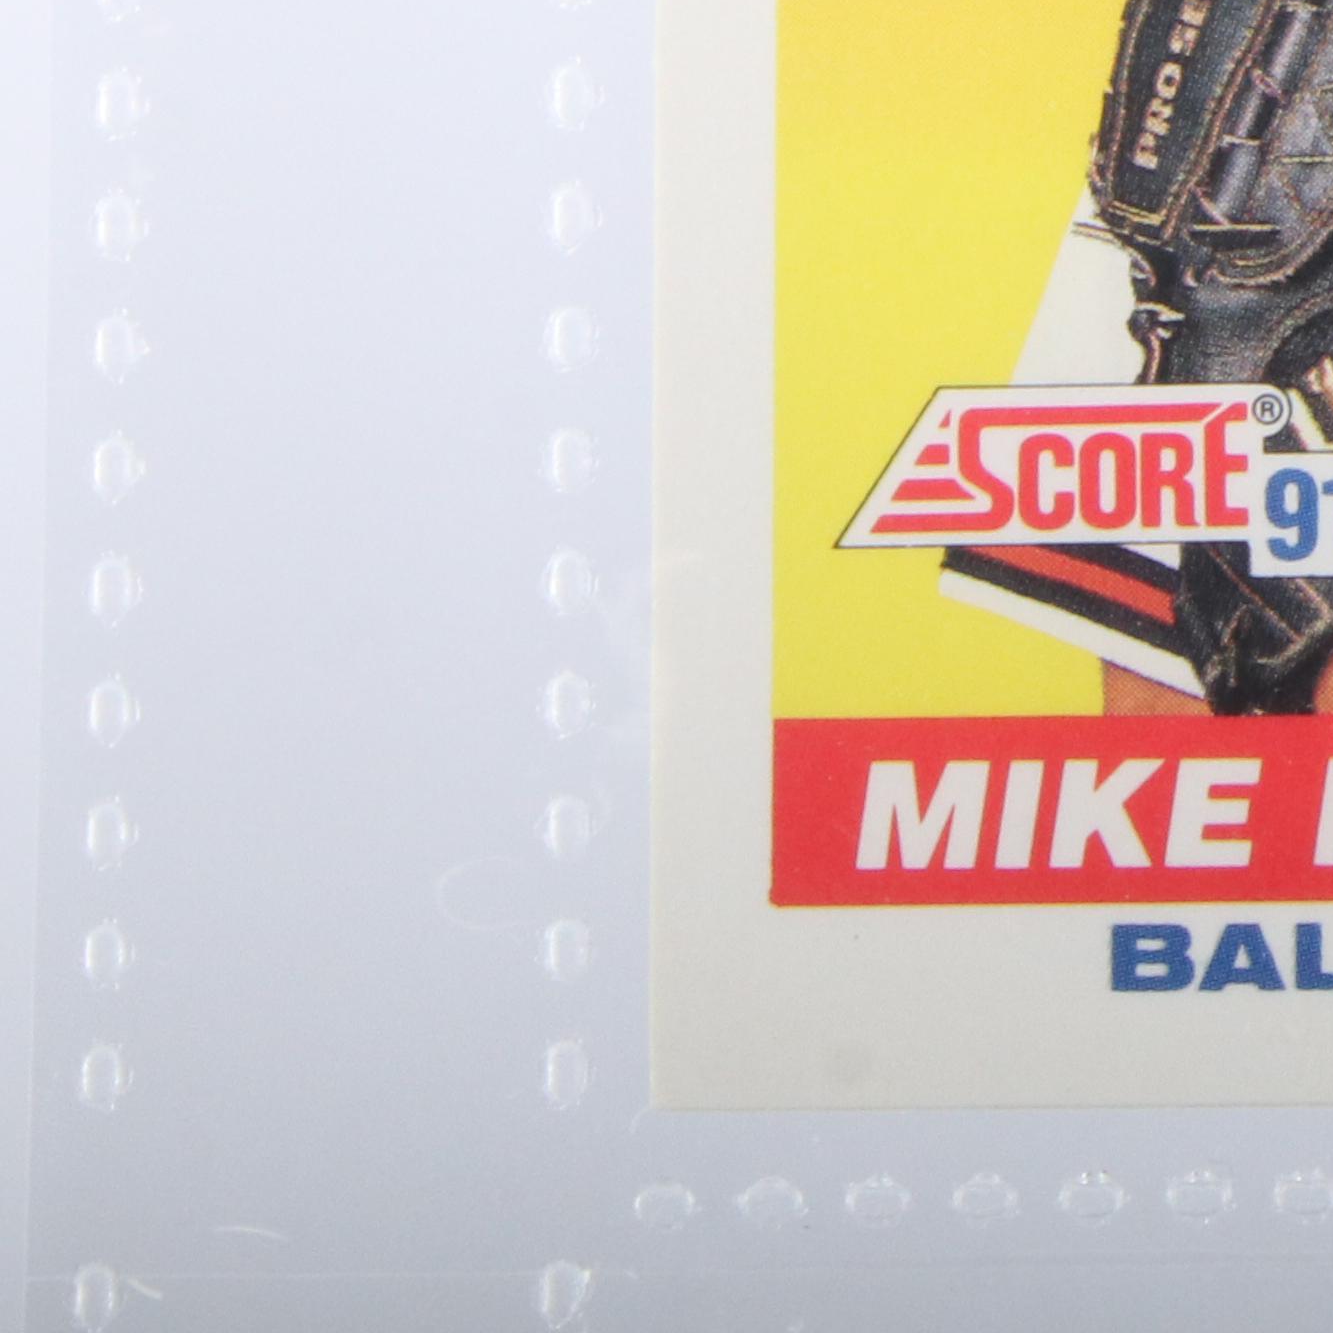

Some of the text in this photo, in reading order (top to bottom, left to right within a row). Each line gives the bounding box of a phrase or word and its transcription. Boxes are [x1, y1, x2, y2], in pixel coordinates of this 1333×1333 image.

[1132, 60, 1184, 170] PRO
[868, 401, 1249, 534] SCORE
[855, 758, 1260, 870] MIKE
